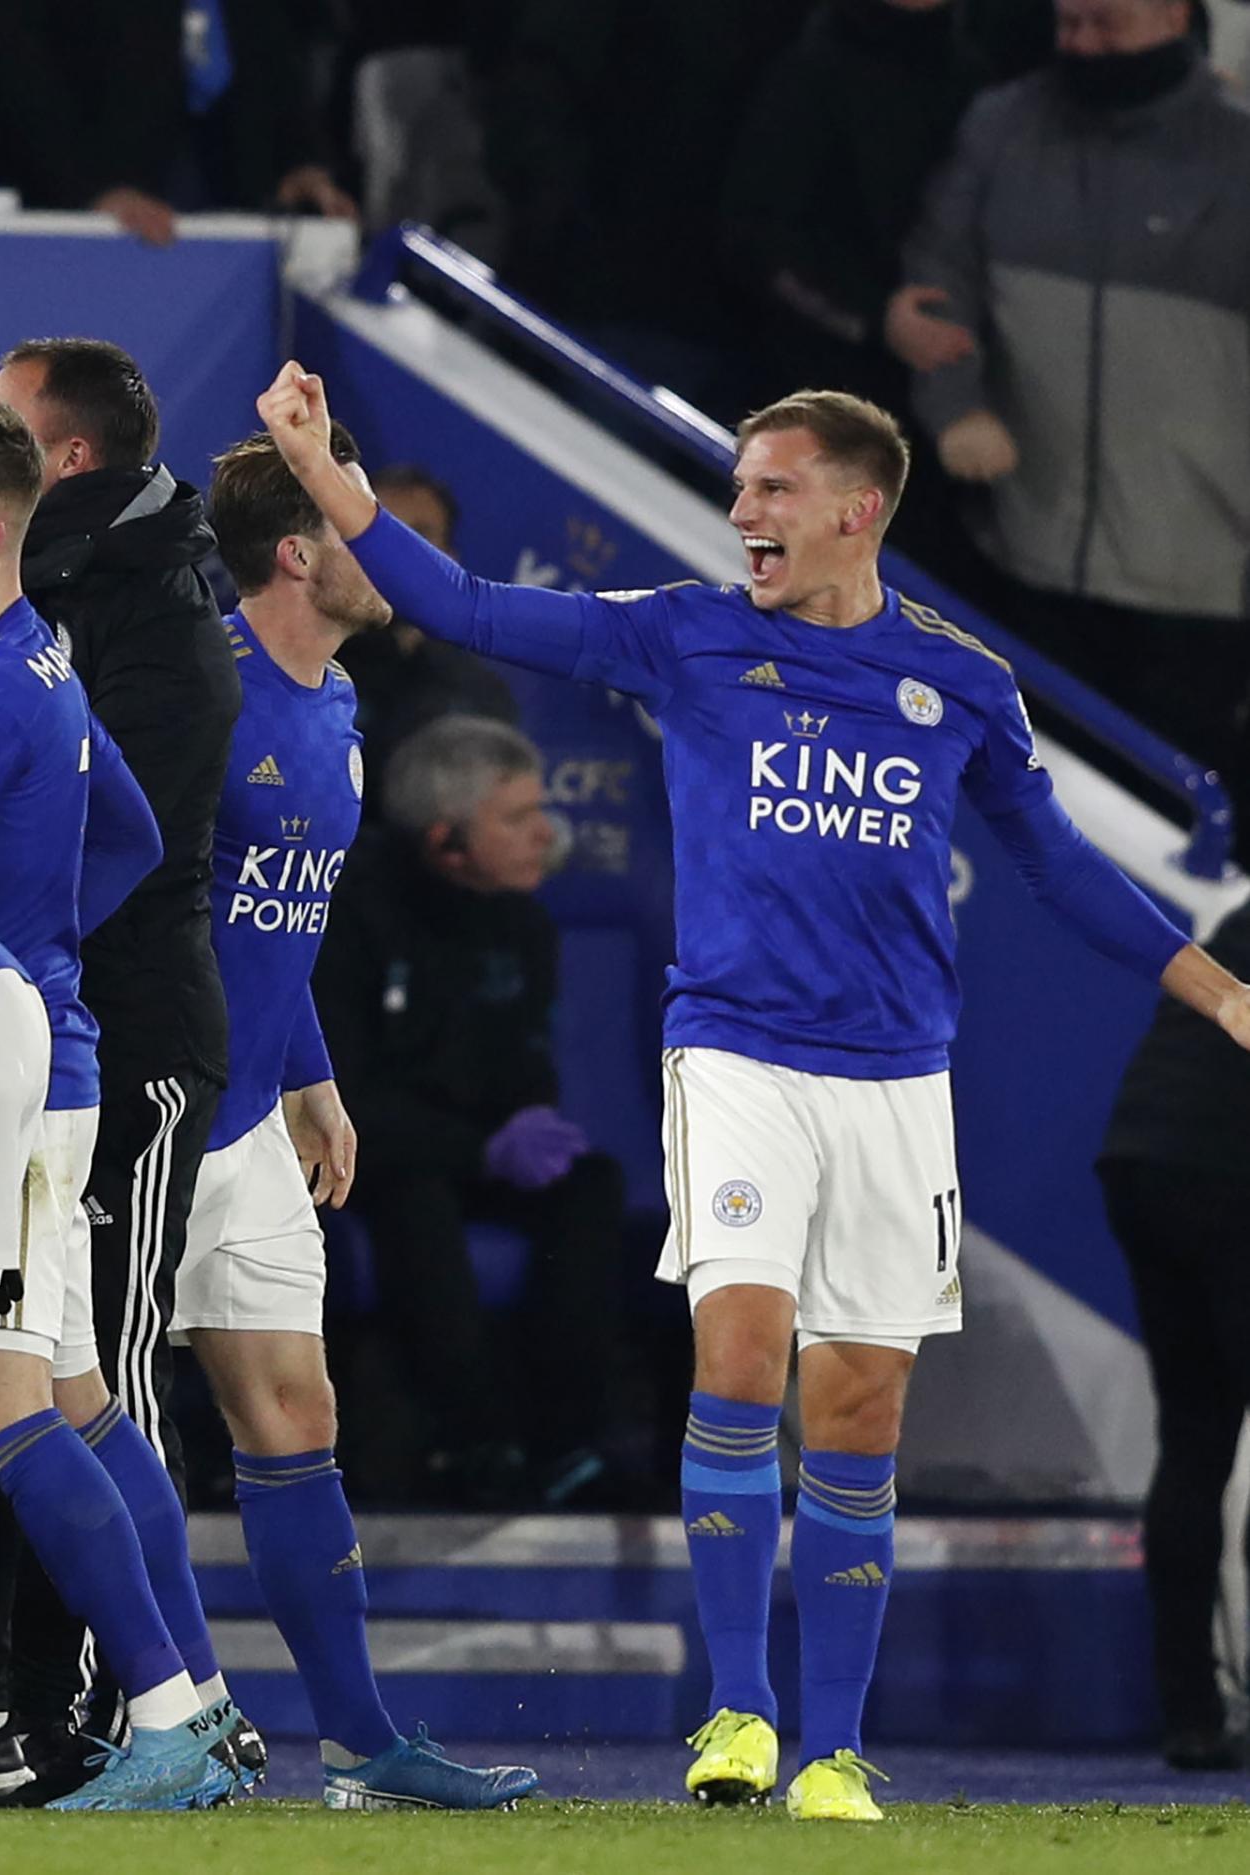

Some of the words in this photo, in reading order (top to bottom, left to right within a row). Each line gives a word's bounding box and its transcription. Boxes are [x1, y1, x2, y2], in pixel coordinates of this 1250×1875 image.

[751, 741, 922, 805] KING
[749, 797, 913, 849] POWER
[238, 846, 346, 893] KING
